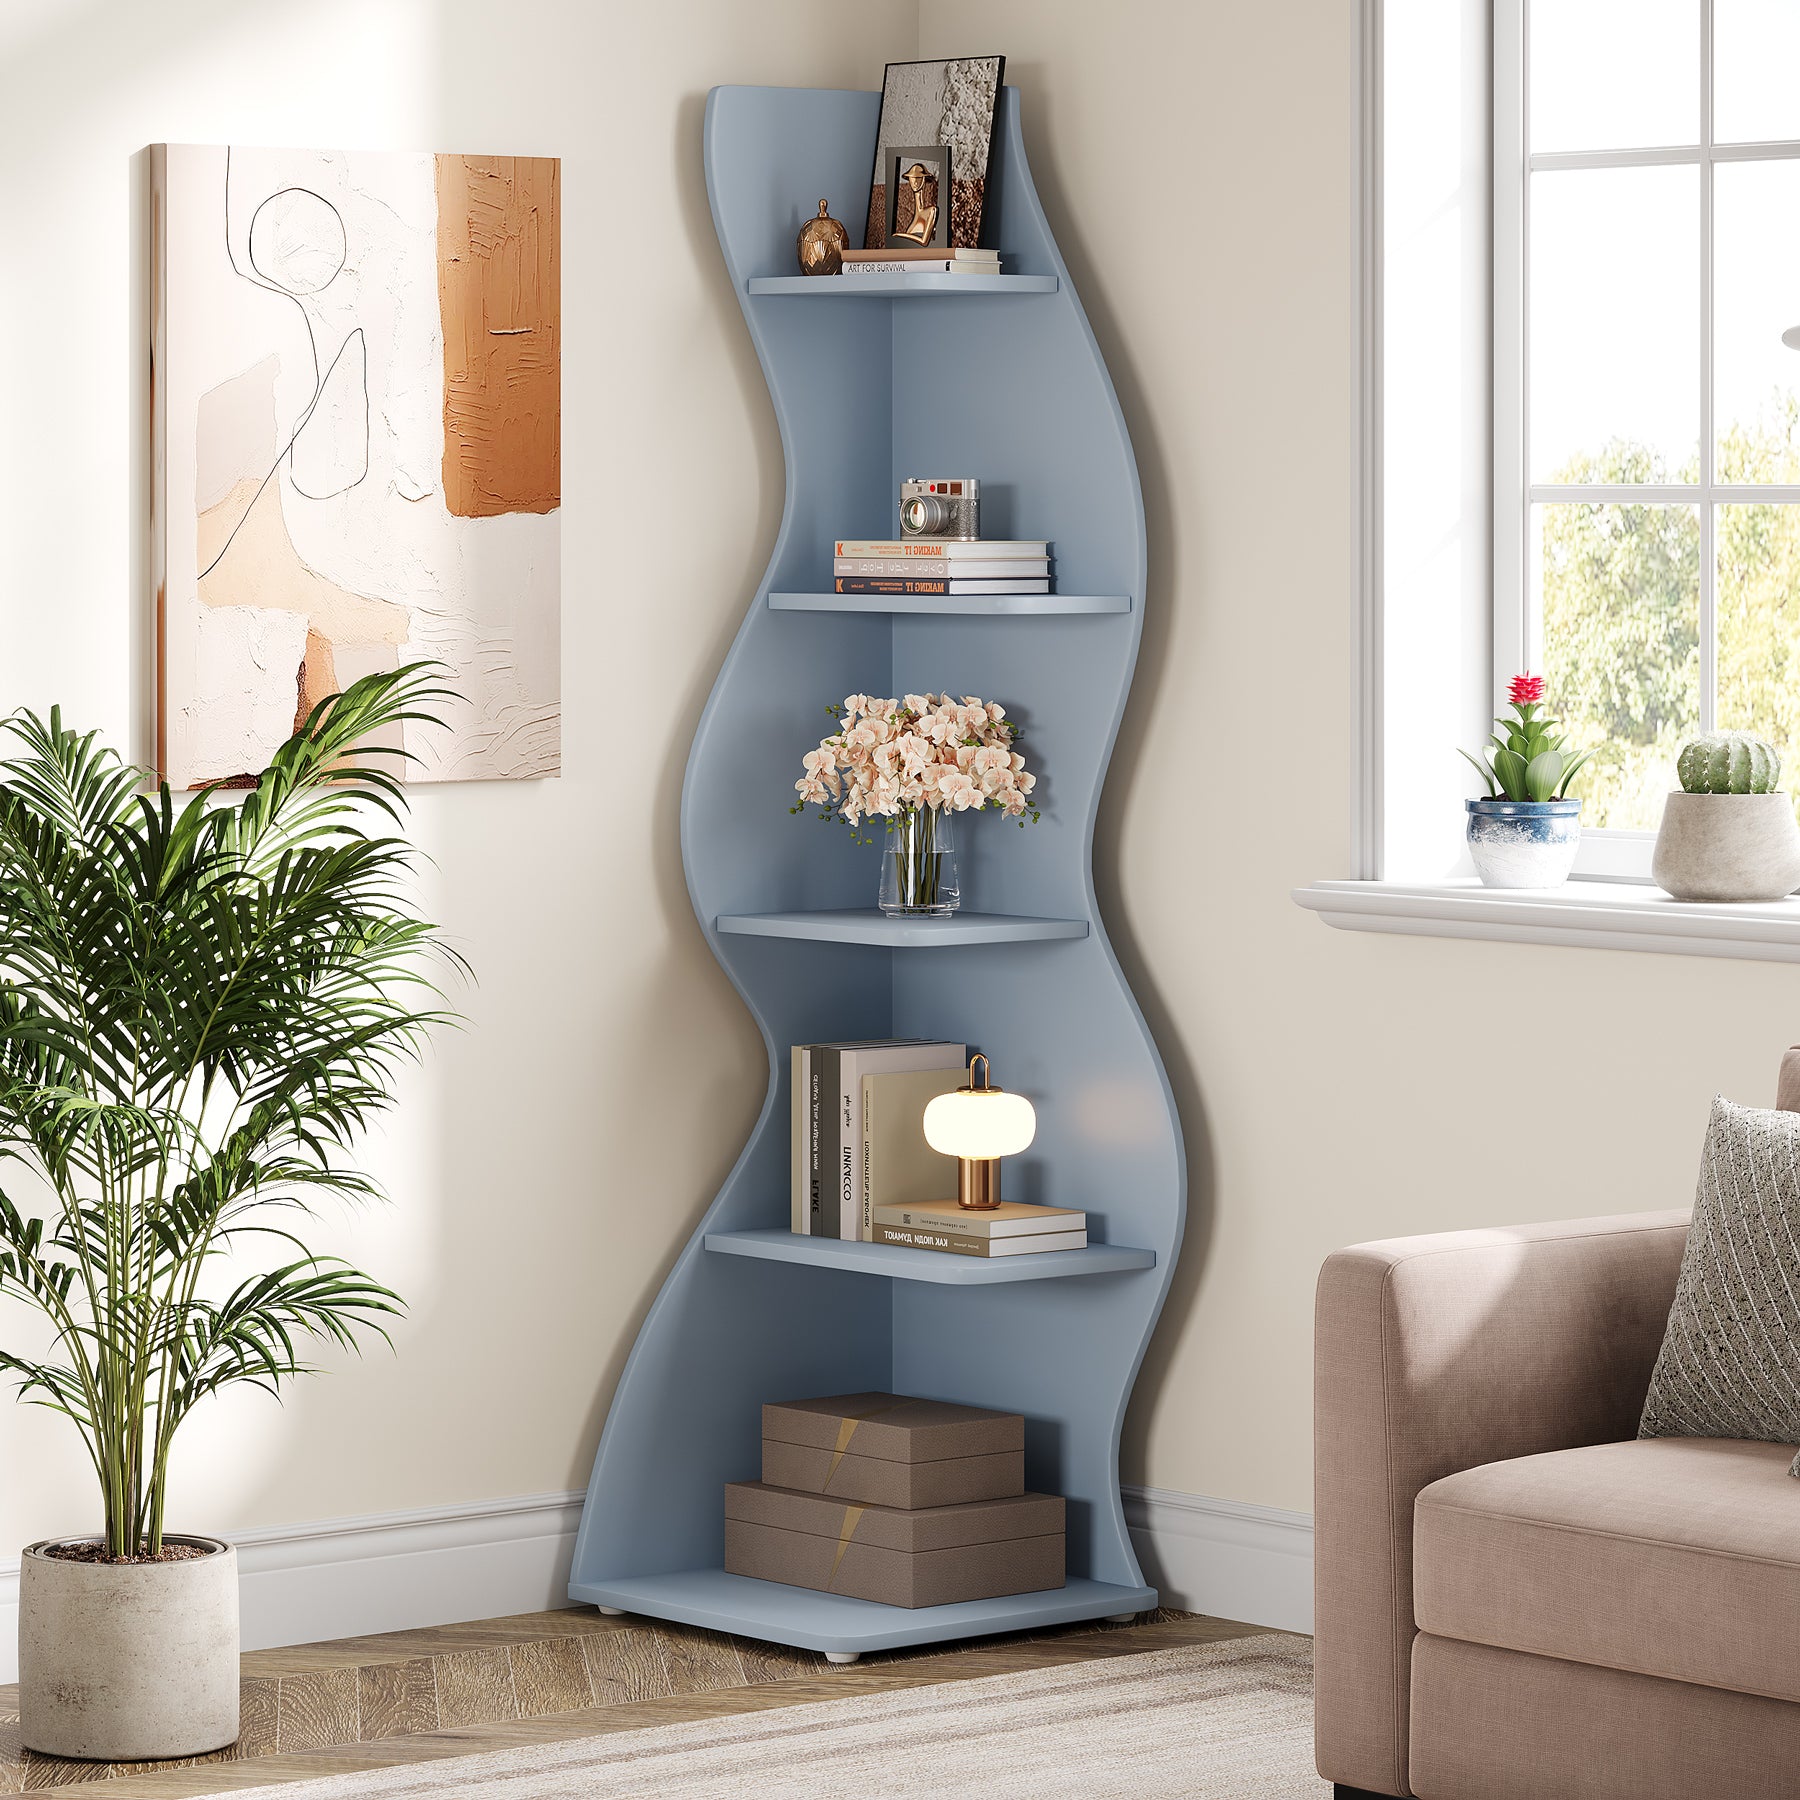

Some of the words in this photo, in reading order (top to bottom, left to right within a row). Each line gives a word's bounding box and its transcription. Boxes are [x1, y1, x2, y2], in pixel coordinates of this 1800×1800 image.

[848, 264, 860, 272] ART
[862, 264, 876, 272] FOR
[877, 263, 906, 272] SURVIVAL
